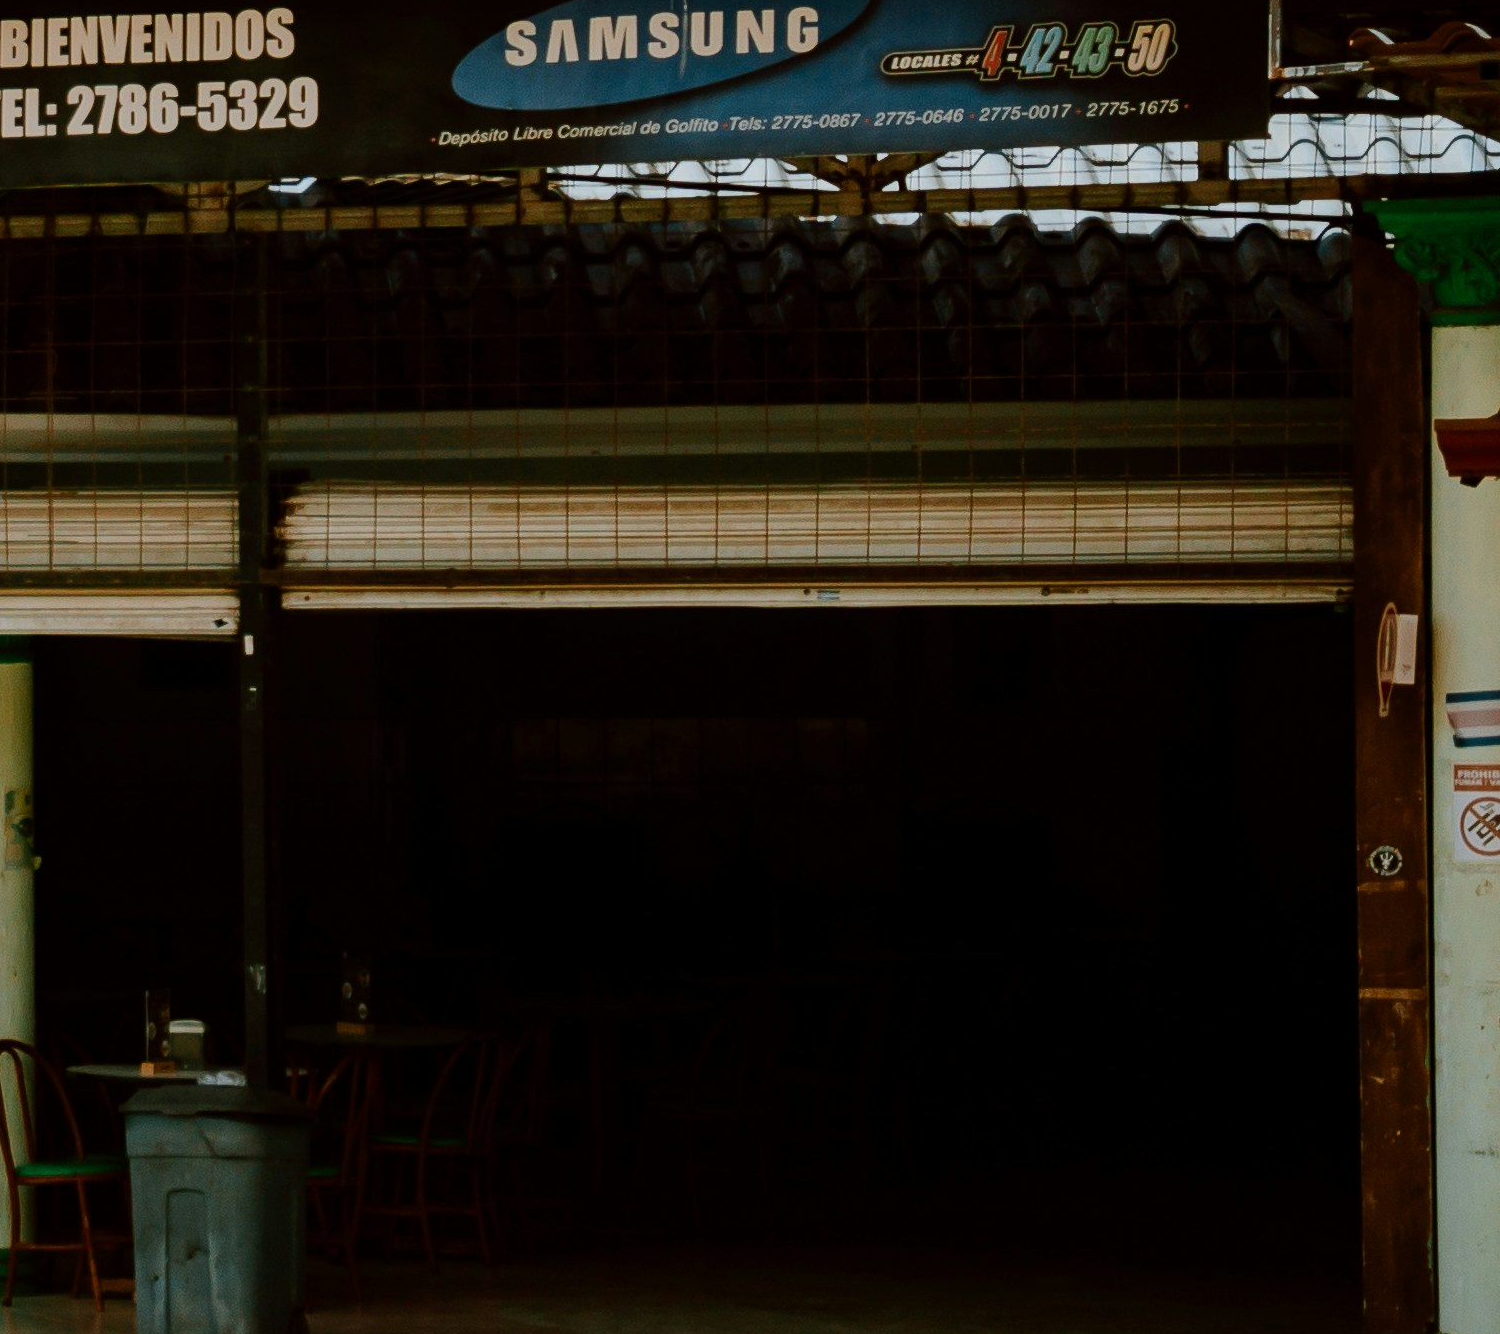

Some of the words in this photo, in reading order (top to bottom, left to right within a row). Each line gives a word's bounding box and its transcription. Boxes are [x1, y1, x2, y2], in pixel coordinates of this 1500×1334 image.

[503, 5, 820, 67] SAMSUNG
[890, 53, 962, 70] LOCALES
[65, 76, 319, 138] 2786-5329
[438, 128, 508, 146] Depósito
[513, 125, 553, 140] Libre
[557, 122, 636, 139] Comercial
[640, 120, 661, 134] de
[665, 117, 719, 133] Golfito
[729, 115, 768, 131] Tels:
[771, 113, 861, 130] 2775-0867
[873, 108, 964, 127] 2775-0646
[978, 103, 1072, 123] 2775-0017
[1085, 99, 1180, 117] 2775-1675
